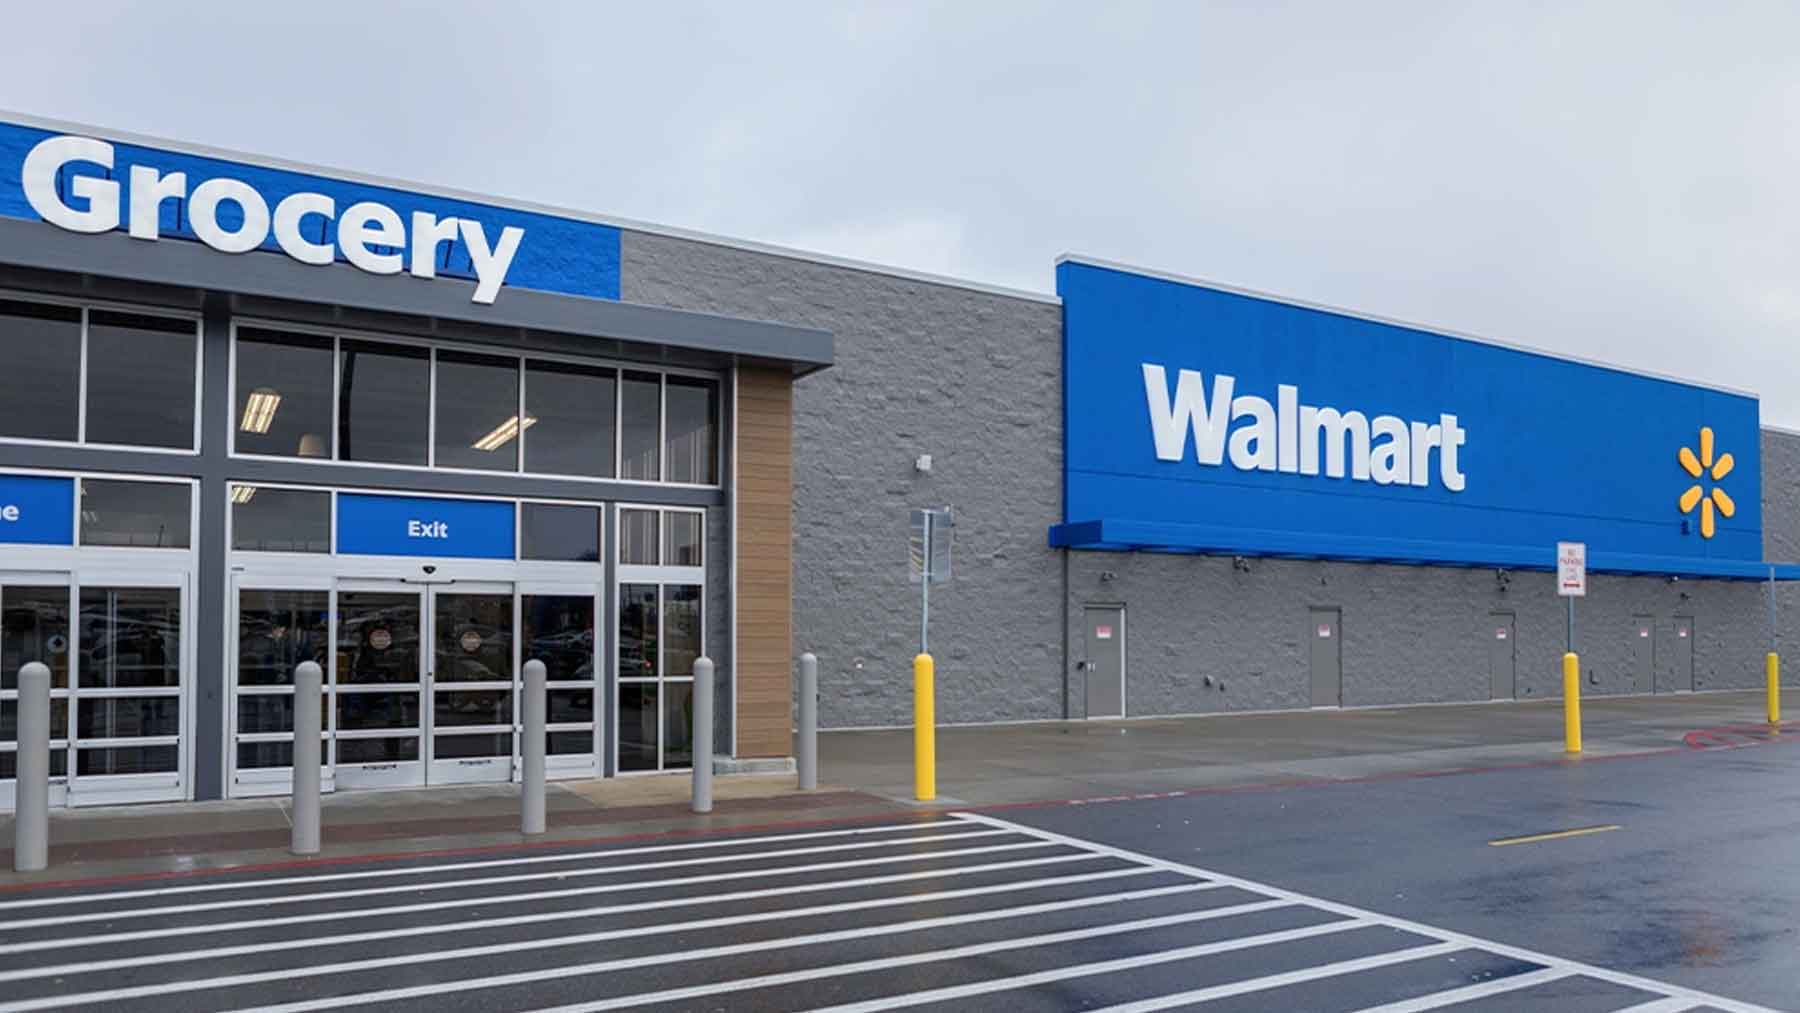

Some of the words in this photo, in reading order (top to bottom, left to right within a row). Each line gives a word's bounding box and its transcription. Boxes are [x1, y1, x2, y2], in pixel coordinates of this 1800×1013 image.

[22, 135, 525, 305] Grocery
[1142, 362, 1467, 491] Walmart
[0, 505, 20, 521] e
[408, 519, 449, 539] Exit
